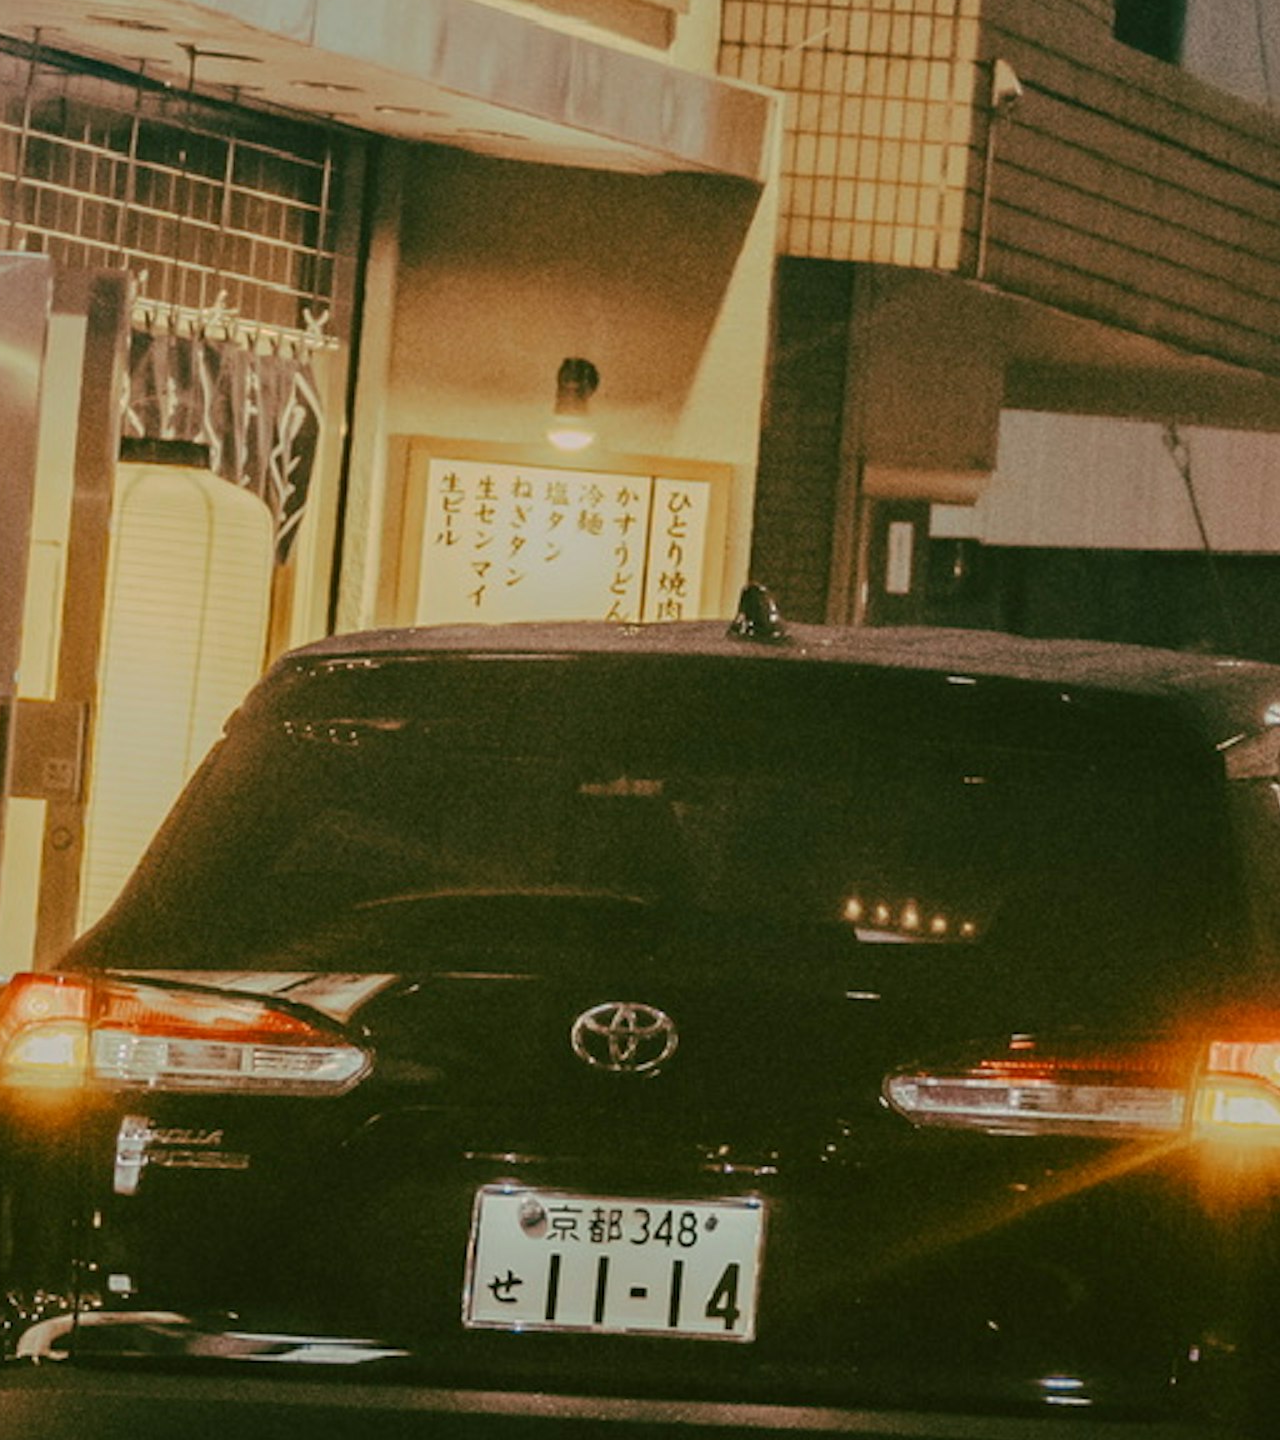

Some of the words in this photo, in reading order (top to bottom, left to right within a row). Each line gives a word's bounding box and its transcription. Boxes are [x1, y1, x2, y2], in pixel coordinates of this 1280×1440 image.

[434, 472, 466, 547] 生ビール
[467, 478, 499, 608] 生センマイ
[503, 475, 534, 588] ねぎタン
[544, 481, 570, 563] 塩タン
[605, 487, 640, 624] かすうどん
[657, 491, 691, 621] ひとり焼肉
[544, 1253, 742, 1331] 11-14
